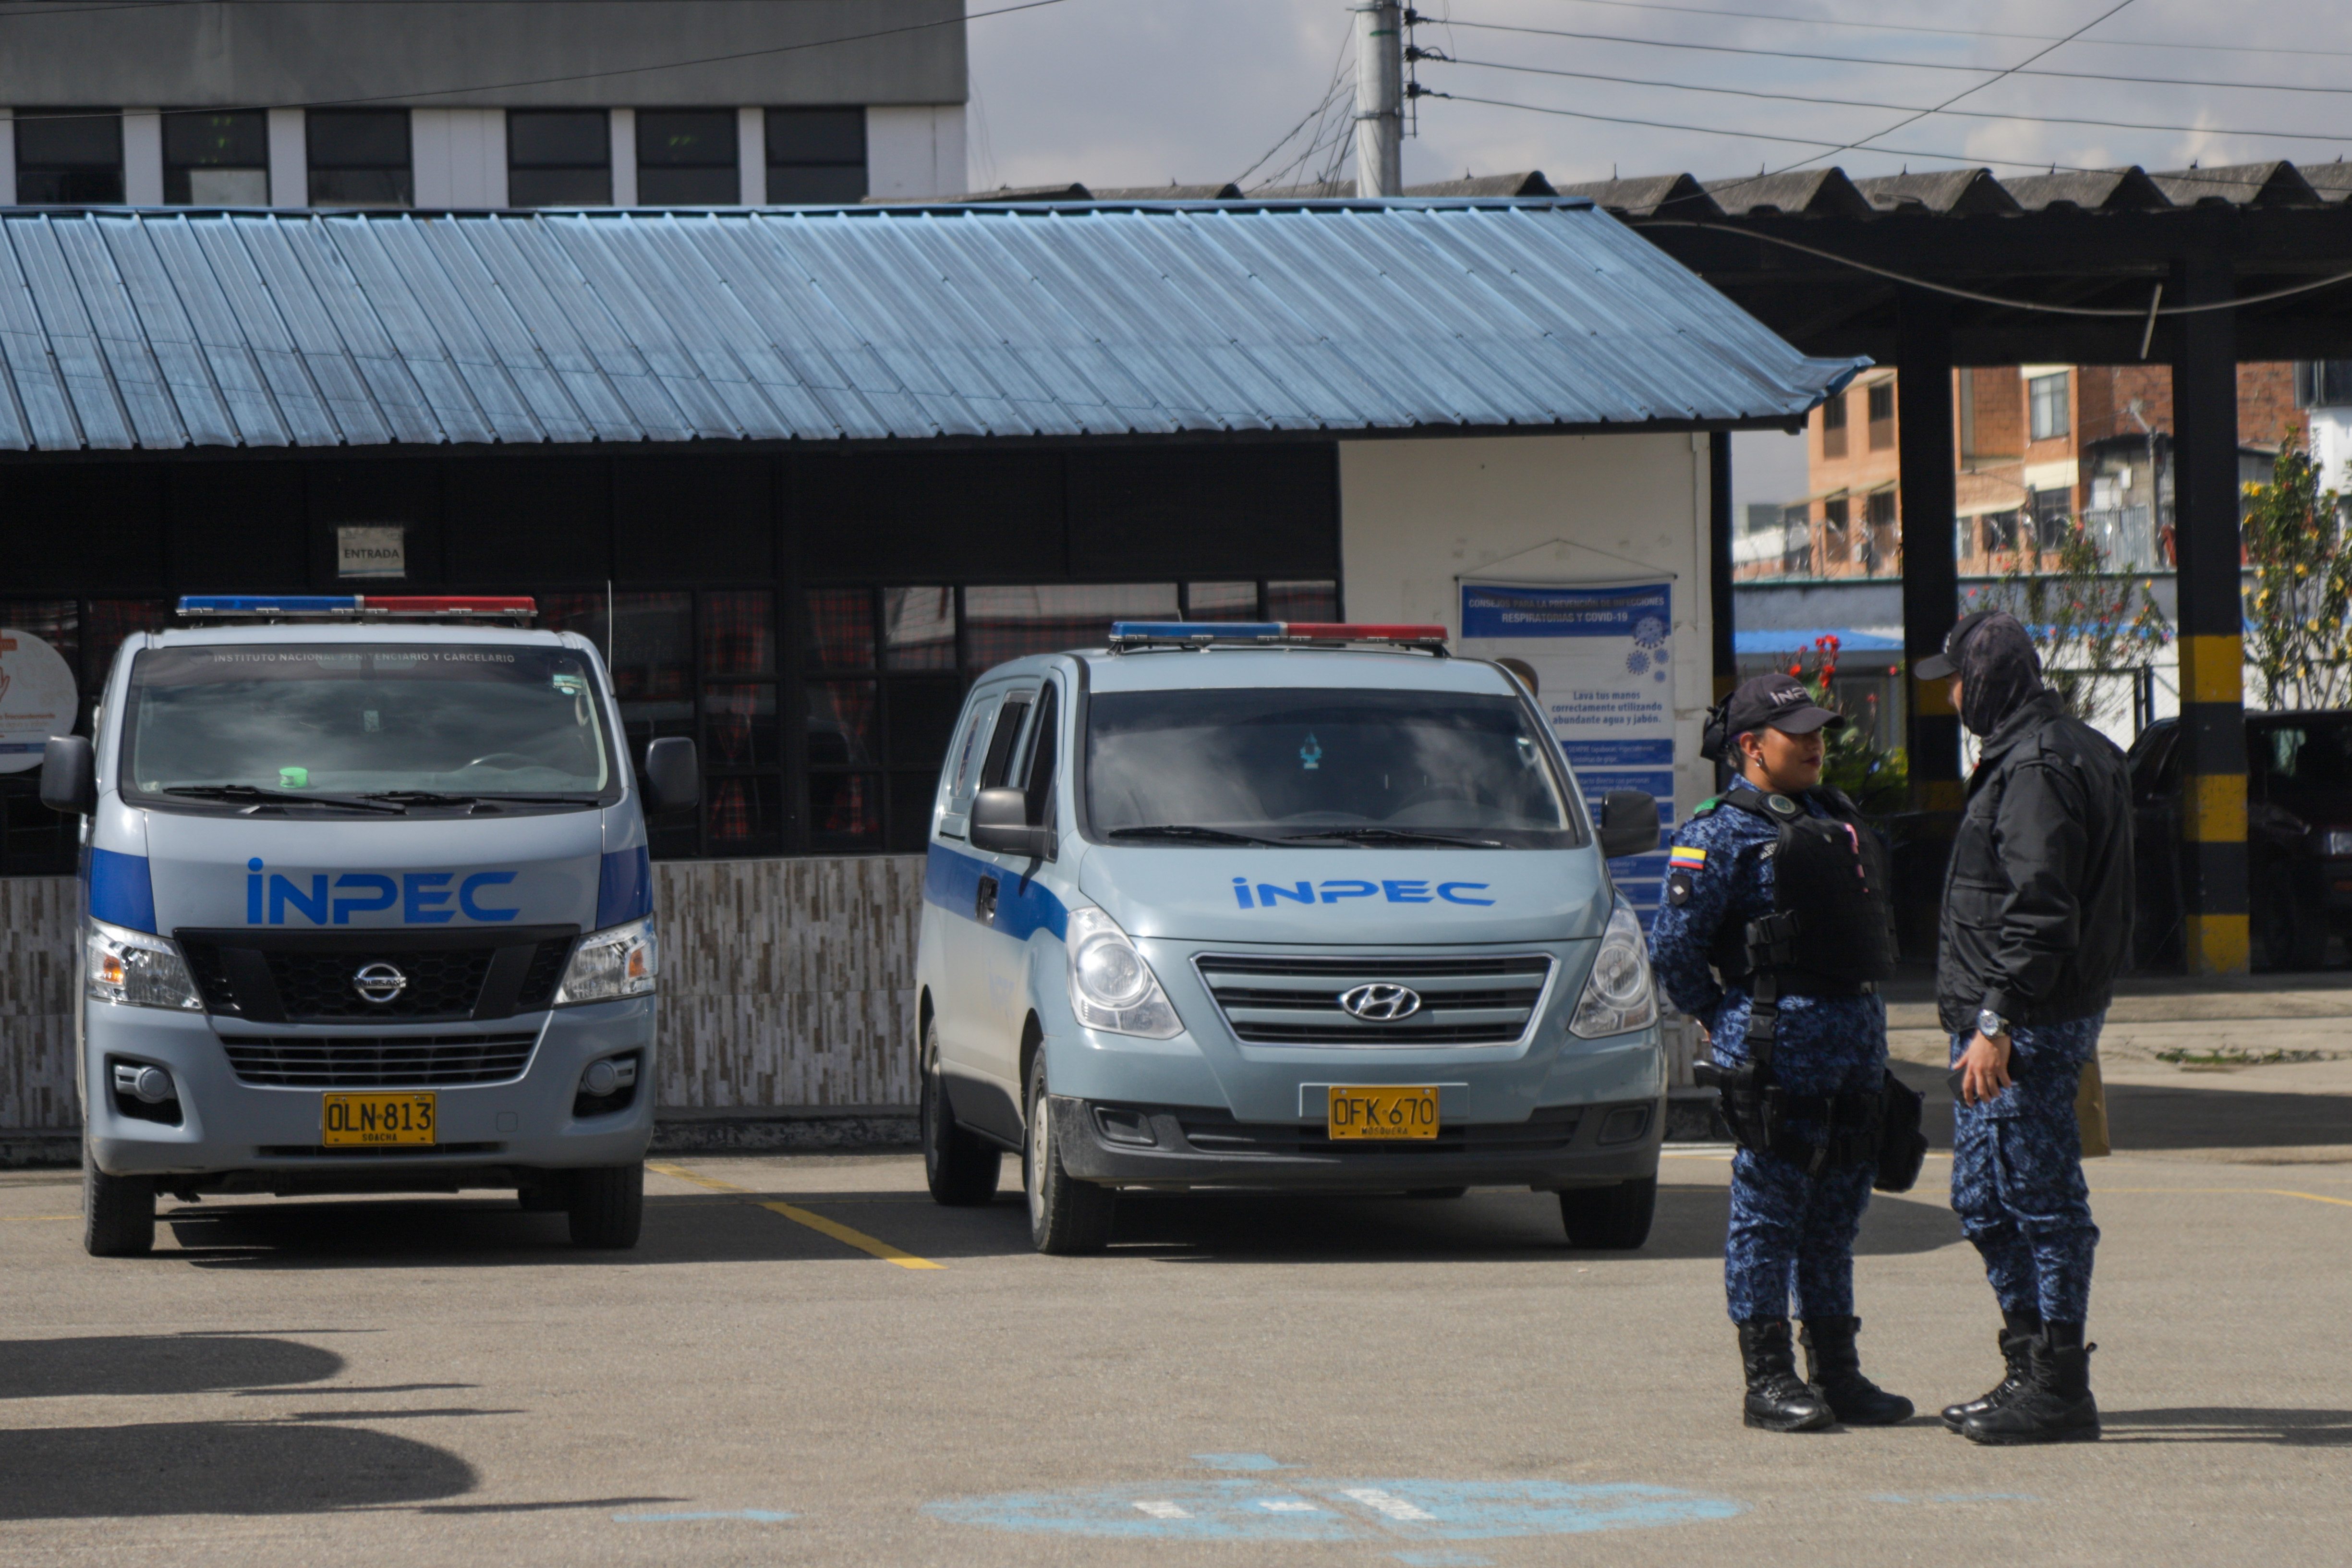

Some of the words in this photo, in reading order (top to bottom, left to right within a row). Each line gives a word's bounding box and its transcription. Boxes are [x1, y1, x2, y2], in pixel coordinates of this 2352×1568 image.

[344, 549, 400, 559] ENTRADA
[1469, 599, 1510, 608] CONSEJOS
[1514, 600, 1535, 608] PARA
[1537, 600, 1547, 608] LA
[1549, 598, 1598, 608] PREVENCIÓN
[1613, 597, 1664, 607] INFECCIONES
[1502, 613, 1574, 623] RESPIRATORIAS
[1577, 613, 1583, 622] Y
[1585, 612, 1628, 622] COVID-19
[214, 654, 276, 662] INSTITUTO
[279, 653, 337, 661] NACIONAL
[444, 653, 515, 663] CARCELARIO
[1573, 692, 1593, 700] Lava
[1552, 704, 1615, 712] correctamente
[1618, 702, 1662, 711] utilizando
[1552, 715, 1600, 724] abundante
[1602, 717, 1624, 726] agua
[1627, 717, 1632, 725] y
[1633, 714, 1661, 725] jabón.
[1361, 1126, 1408, 1135] MOSQUERA
[363, 1133, 398, 1142] SOACHA
